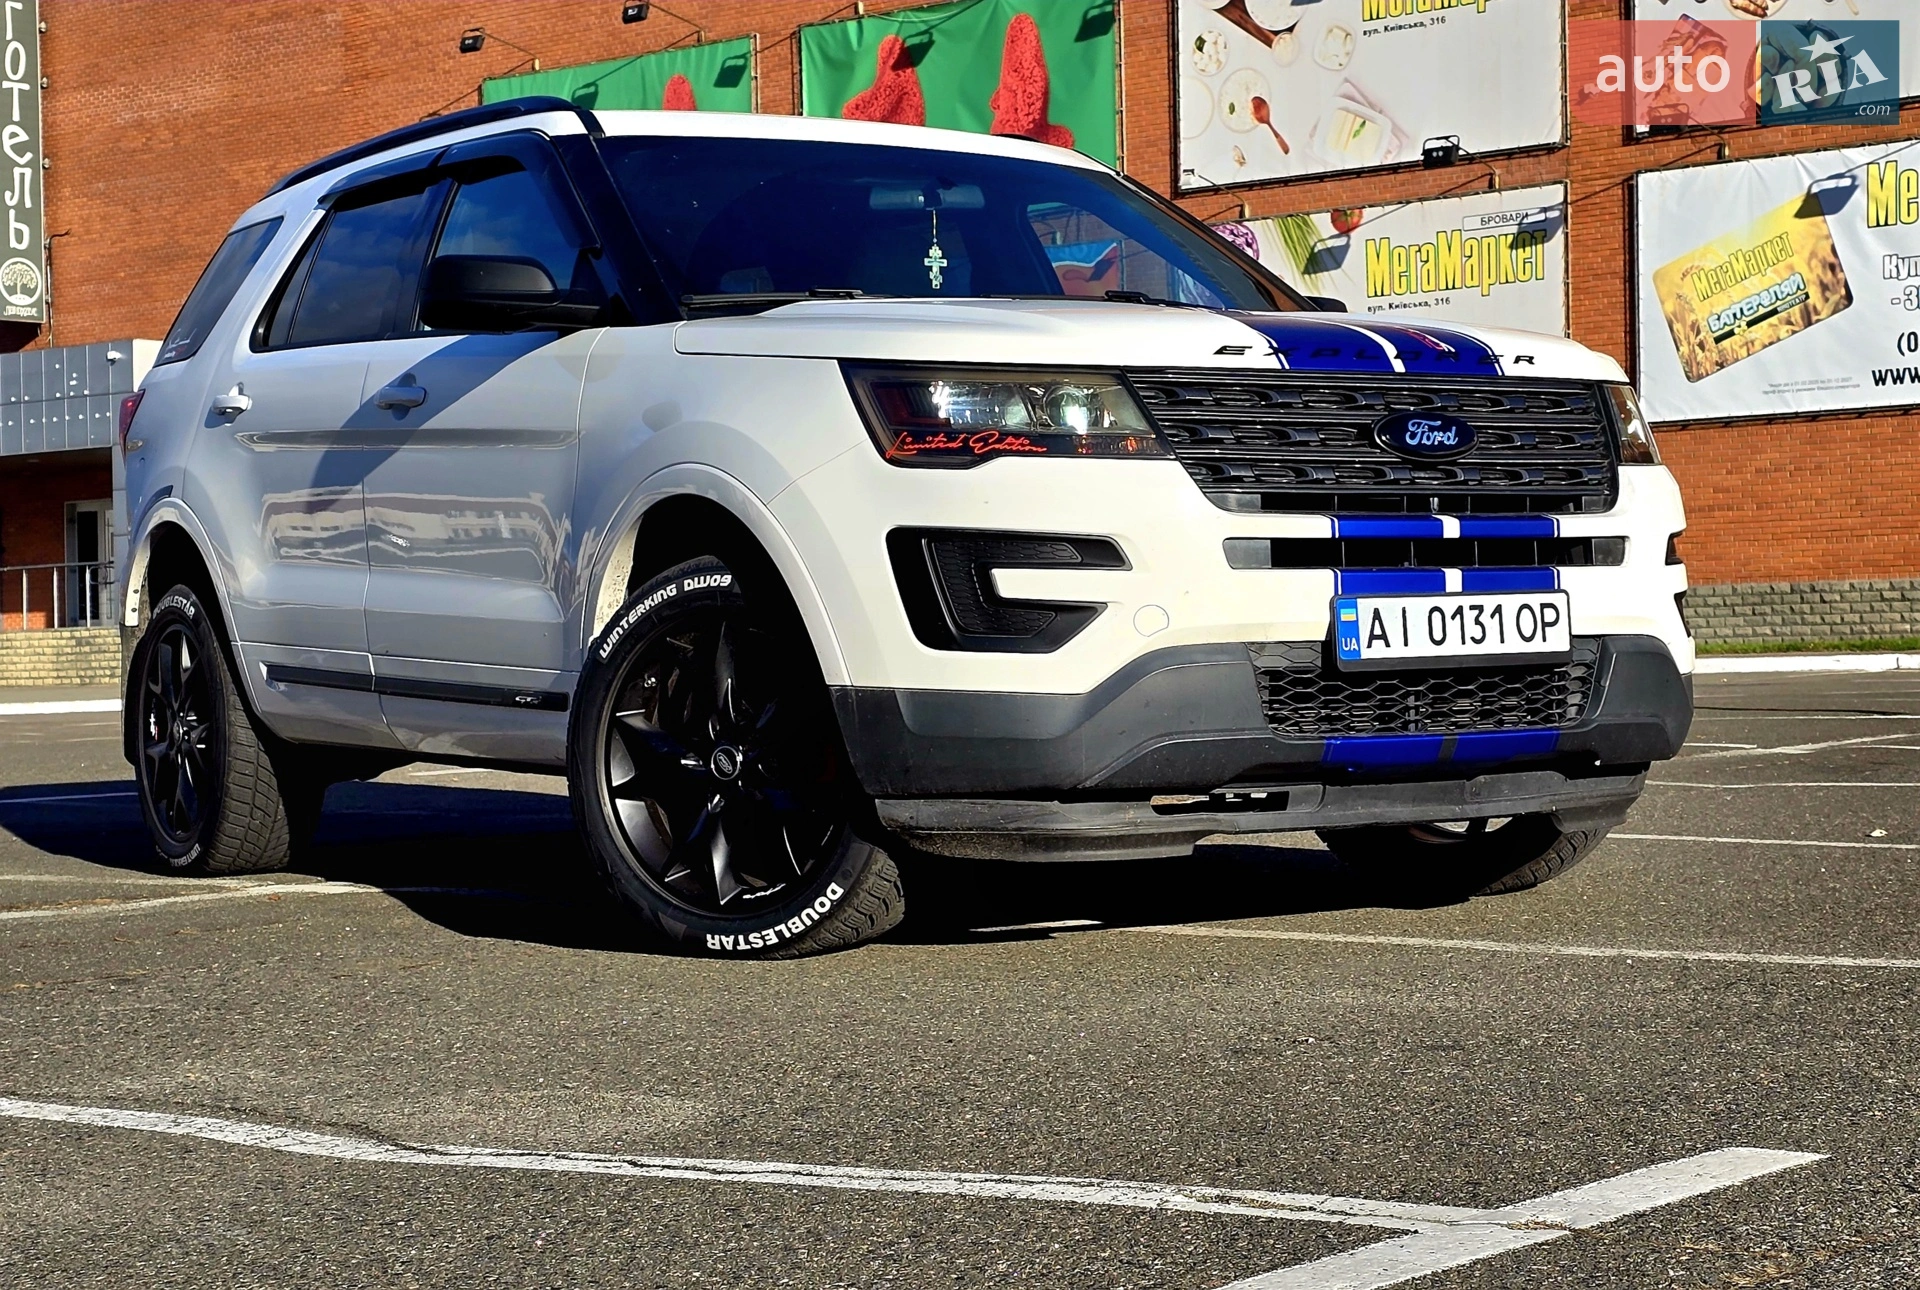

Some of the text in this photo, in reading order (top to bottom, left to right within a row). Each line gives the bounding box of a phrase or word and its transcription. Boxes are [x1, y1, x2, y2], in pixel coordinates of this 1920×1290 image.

[1430, 16, 1446, 26] 316
[1480, 211, 1529, 226] БРОВАРИ
[1365, 229, 1548, 298] МегаМаркет
[1691, 232, 1794, 302] МегаМаркет
[1367, 297, 1450, 315] вул. Київська, 316
[1213, 345, 1535, 366] EXPLORER
[886, 430, 1047, 459] Limited Edition
[1406, 419, 1459, 446] Ford
[599, 583, 678, 660] WINTERKING
[1428, 604, 1504, 647] 0131
[1341, 636, 1359, 652] UA
[706, 881, 845, 952] DOUBLESTAR
